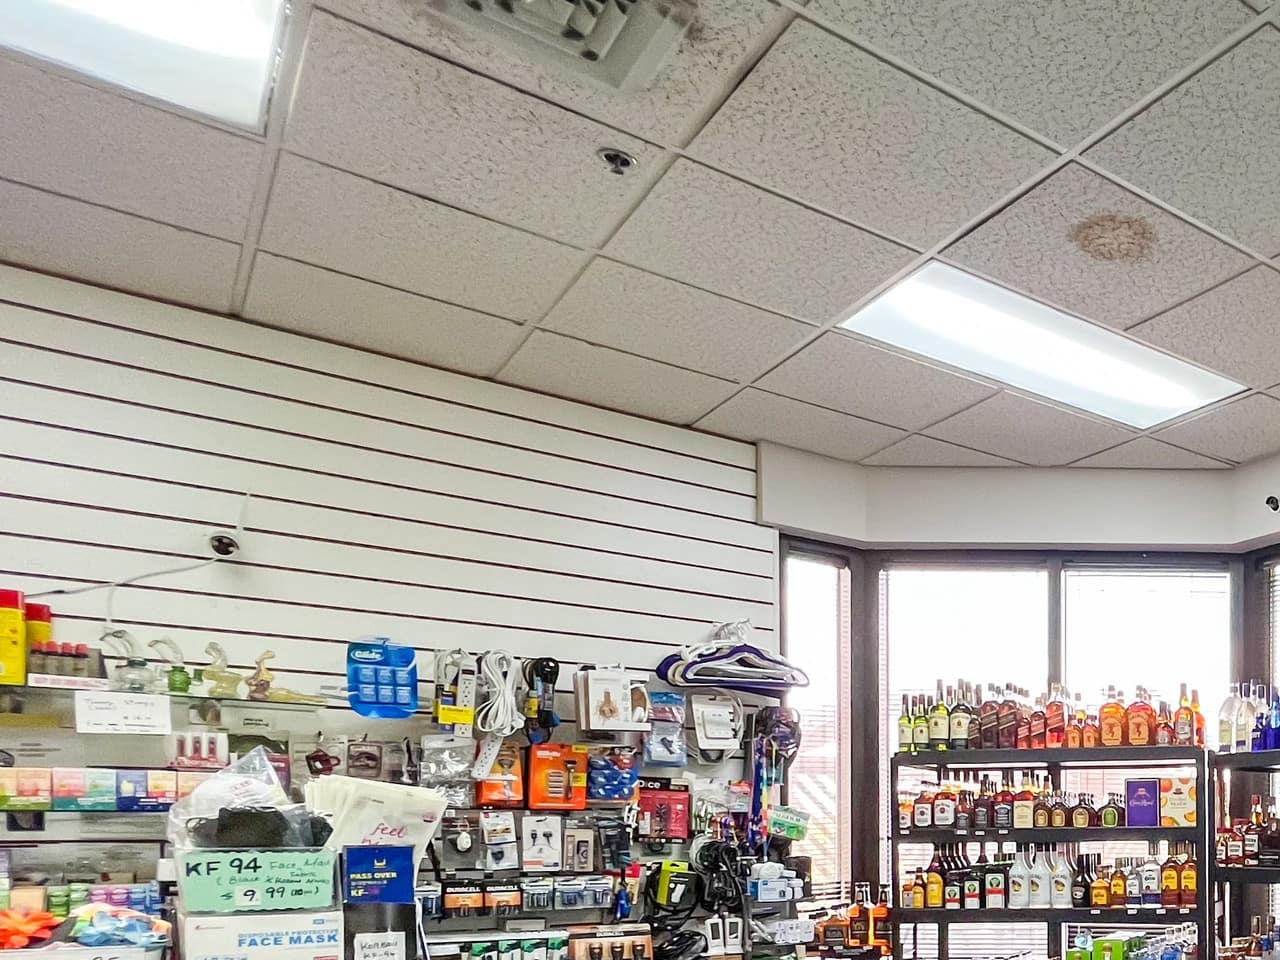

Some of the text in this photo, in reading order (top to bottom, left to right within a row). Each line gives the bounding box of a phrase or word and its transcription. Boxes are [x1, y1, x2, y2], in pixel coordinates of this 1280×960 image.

[229, 857, 262, 874] 94
[238, 934, 338, 947] FACE MASK
